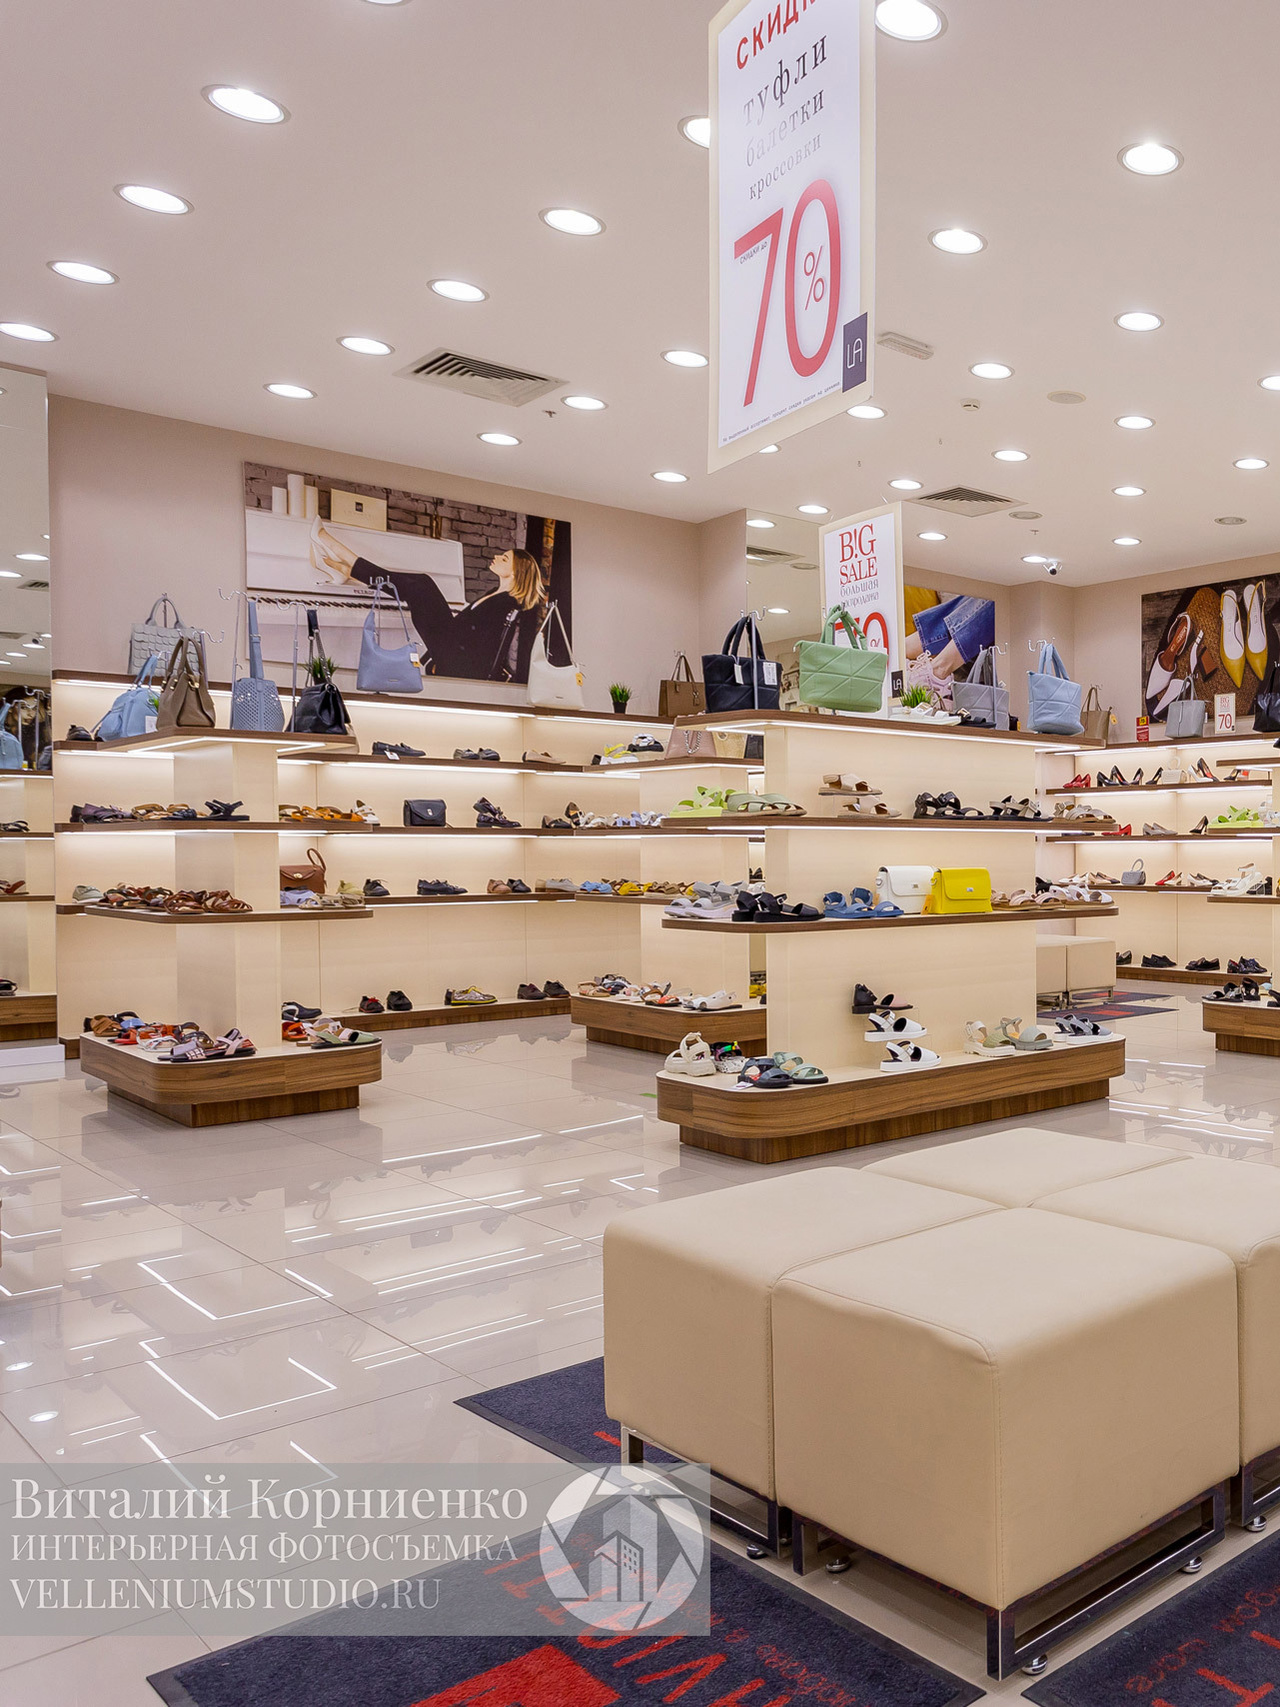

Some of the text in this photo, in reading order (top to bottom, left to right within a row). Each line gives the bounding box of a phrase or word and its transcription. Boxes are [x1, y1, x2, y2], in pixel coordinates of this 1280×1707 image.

[743, 35, 828, 127] туфли
[746, 89, 824, 167] балетки
[749, 133, 822, 201] кроссовки
[839, 556, 878, 586] SALE
[840, 577, 879, 598] большая
